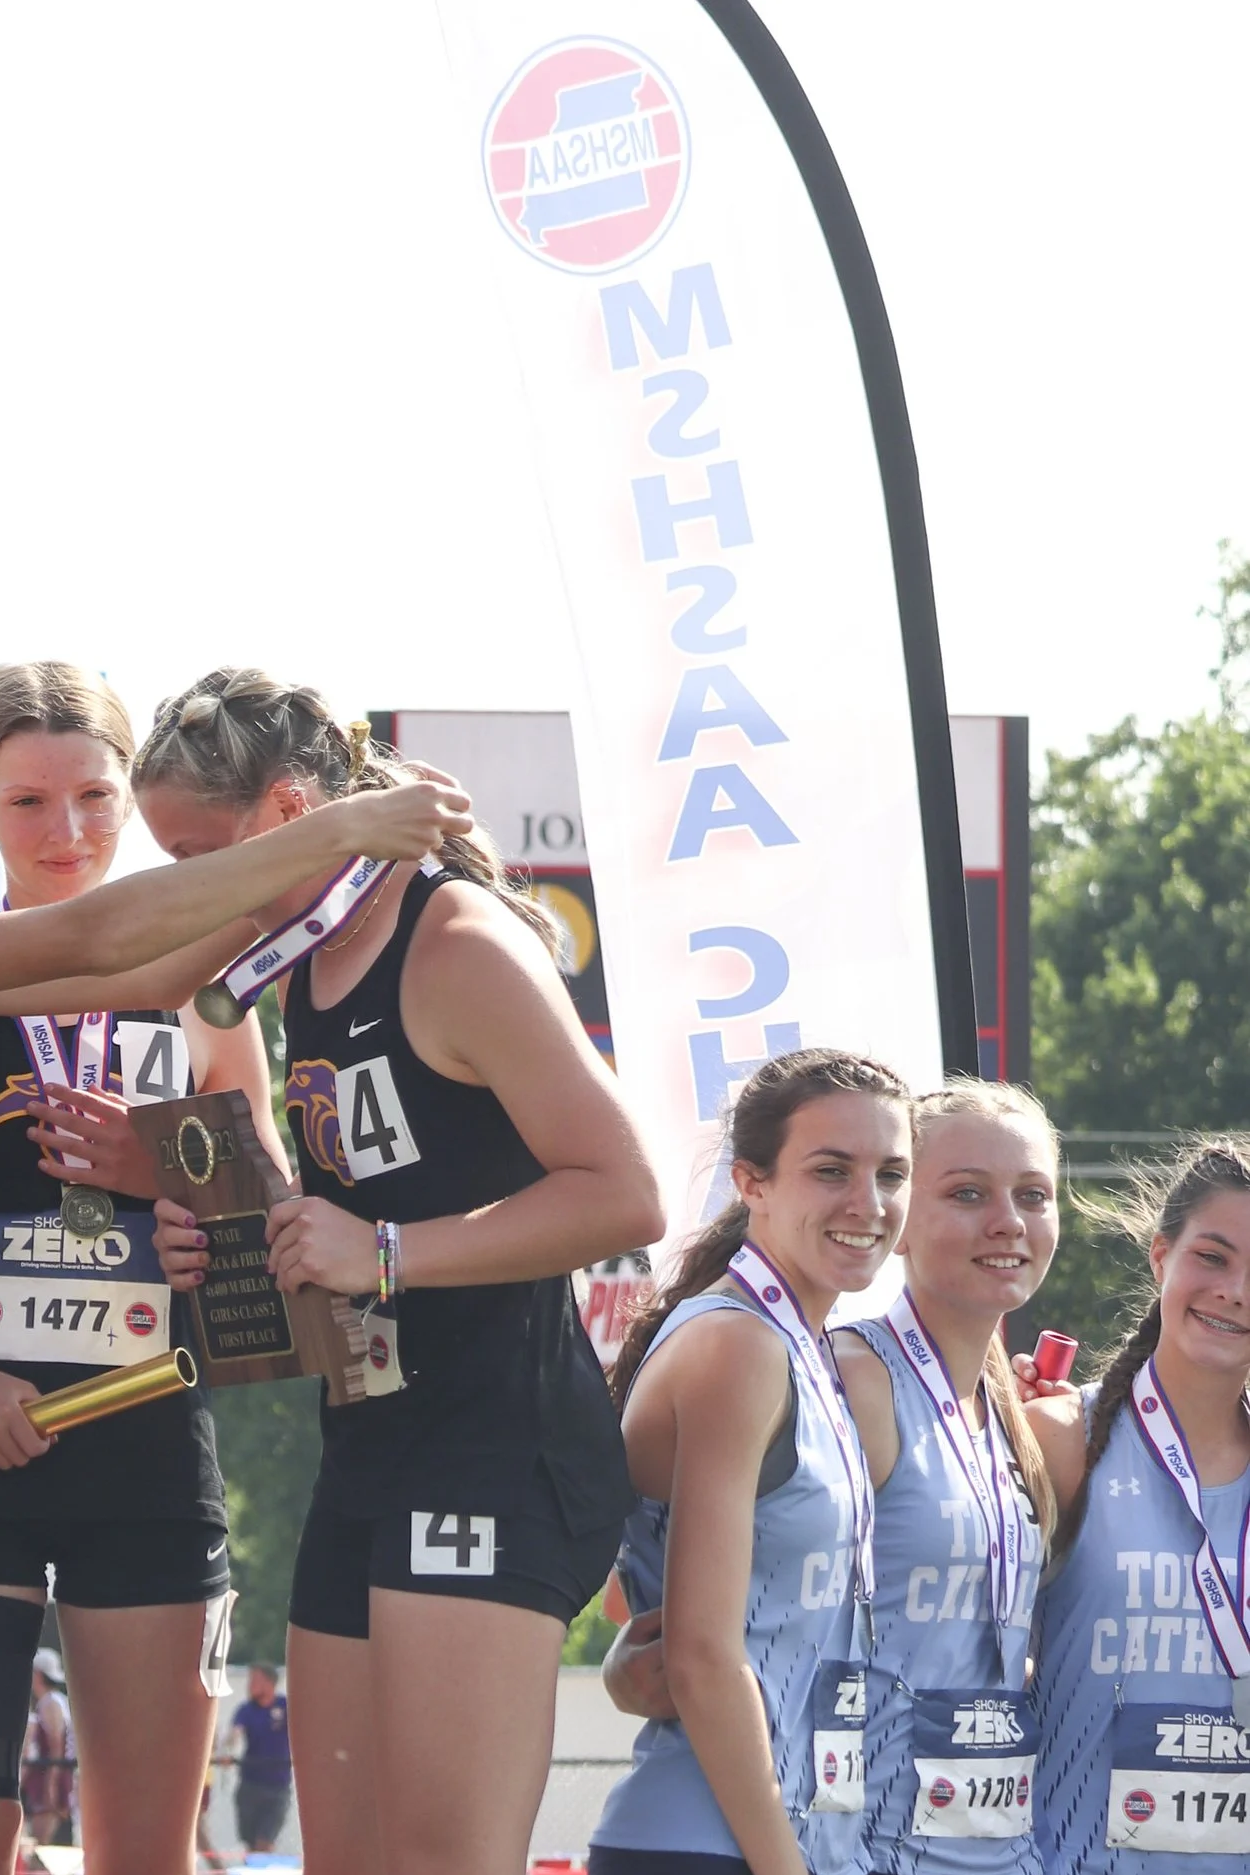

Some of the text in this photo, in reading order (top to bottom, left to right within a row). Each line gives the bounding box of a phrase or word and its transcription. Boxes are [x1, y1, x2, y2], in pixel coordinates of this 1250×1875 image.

[522, 813, 586, 852] JO
[350, 857, 382, 890] MSHSA
[251, 949, 284, 977] MSHSAA
[31, 1023, 55, 1065] MSHSAA
[81, 1063, 98, 1092] HSAA
[135, 1030, 180, 1100] 4
[351, 1068, 398, 1165] 4
[34, 1216, 64, 1229] SHO
[213, 1227, 243, 1244] STATE
[2, 1227, 131, 1266] ZERO
[207, 1254, 231, 1272] ACK
[240, 1250, 268, 1268] FIELD
[240, 1275, 271, 1293] RELAY
[20, 1296, 110, 1333] 1477
[210, 1308, 237, 1324] GIRLS
[238, 1303, 269, 1320] CLASS
[218, 1327, 278, 1349] FIRST PLACE
[903, 1328, 931, 1367] MSHSAA
[1163, 1443, 1191, 1480] MSHSAA
[425, 1513, 480, 1568] 4
[1007, 1523, 1016, 1565] MSHSAA
[800, 1551, 854, 1612] CA
[1200, 1567, 1225, 1610] MSHSAA
[1090, 1615, 1226, 1676] CATH
[951, 1710, 1025, 1744] ZERO
[1184, 1713, 1239, 1726] SHOW-M
[966, 1776, 1015, 1808] 1178
[1171, 1790, 1247, 1823] 1174
